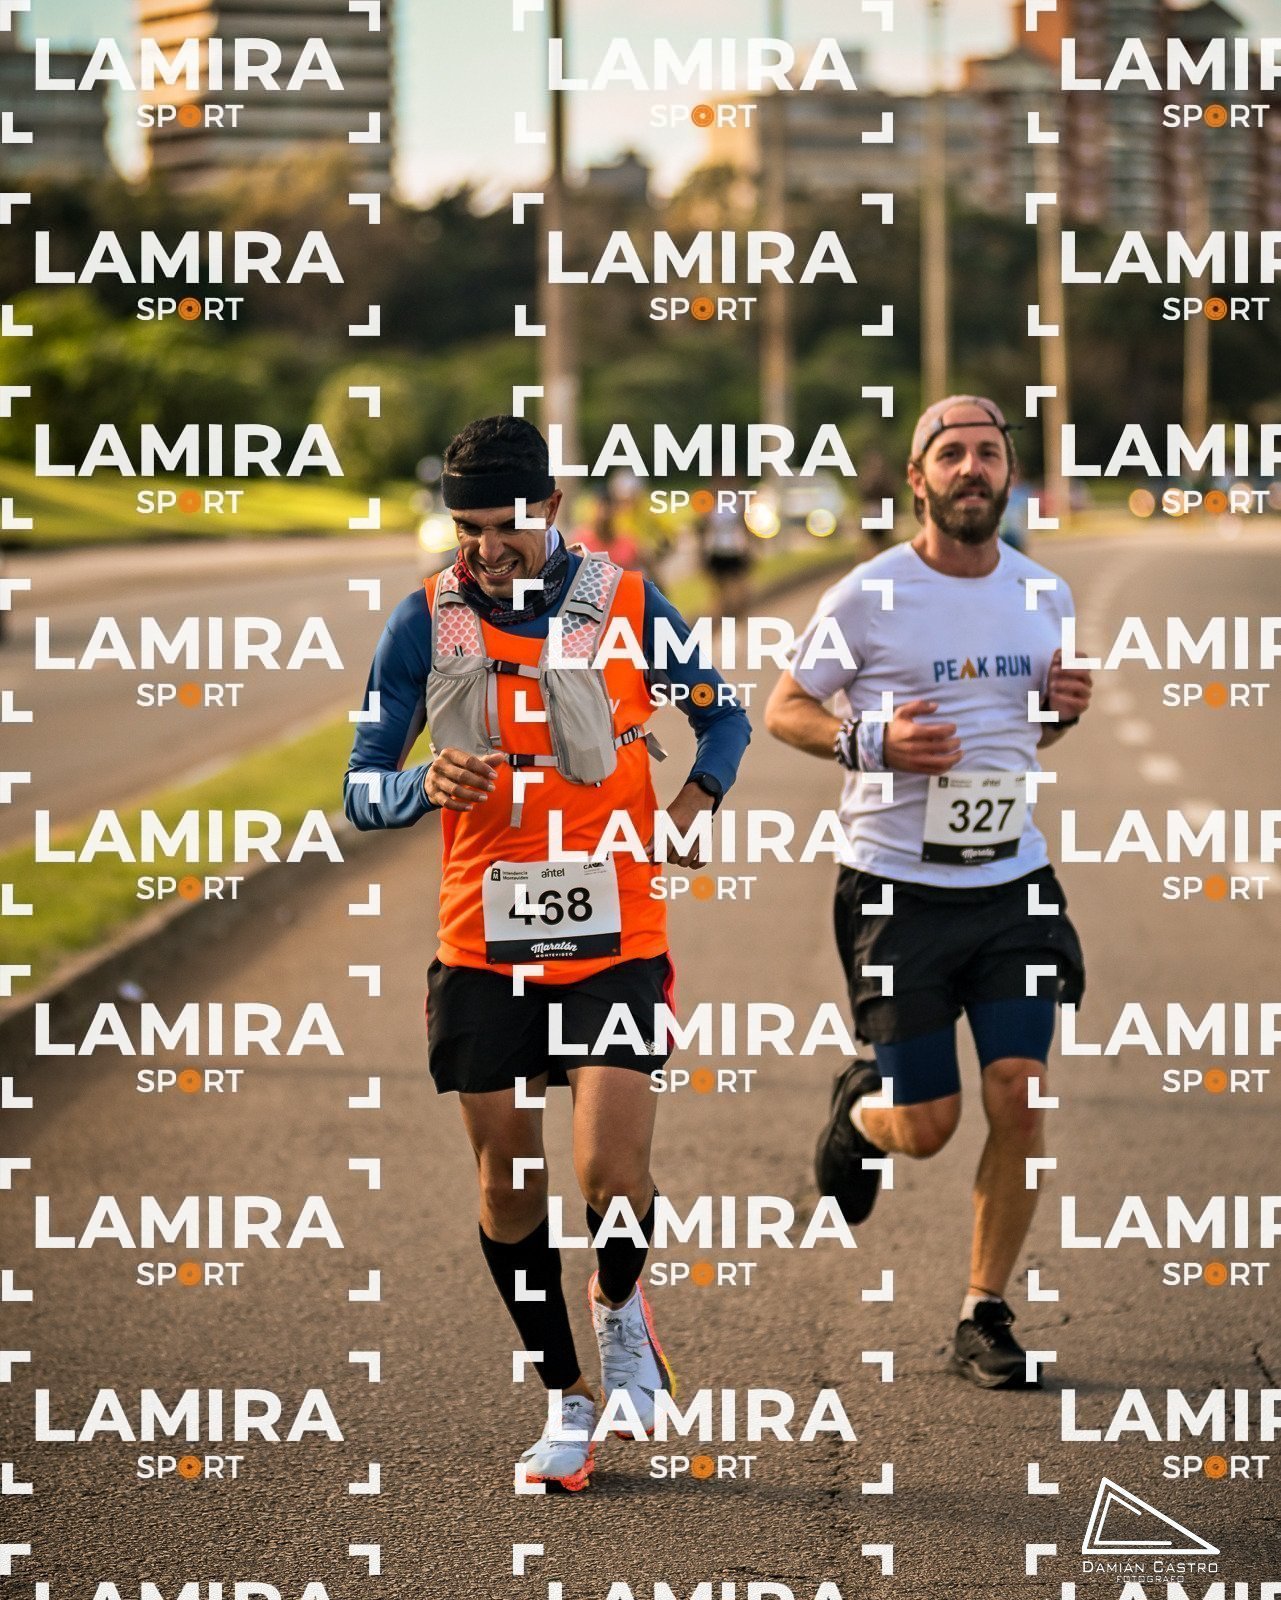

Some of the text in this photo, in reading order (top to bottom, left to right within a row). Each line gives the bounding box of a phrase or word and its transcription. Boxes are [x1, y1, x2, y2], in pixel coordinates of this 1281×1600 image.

[933, 654, 1031, 683] PEAK RUN
[949, 798, 1016, 833] 327
[530, 941, 578, 954] Maratón
